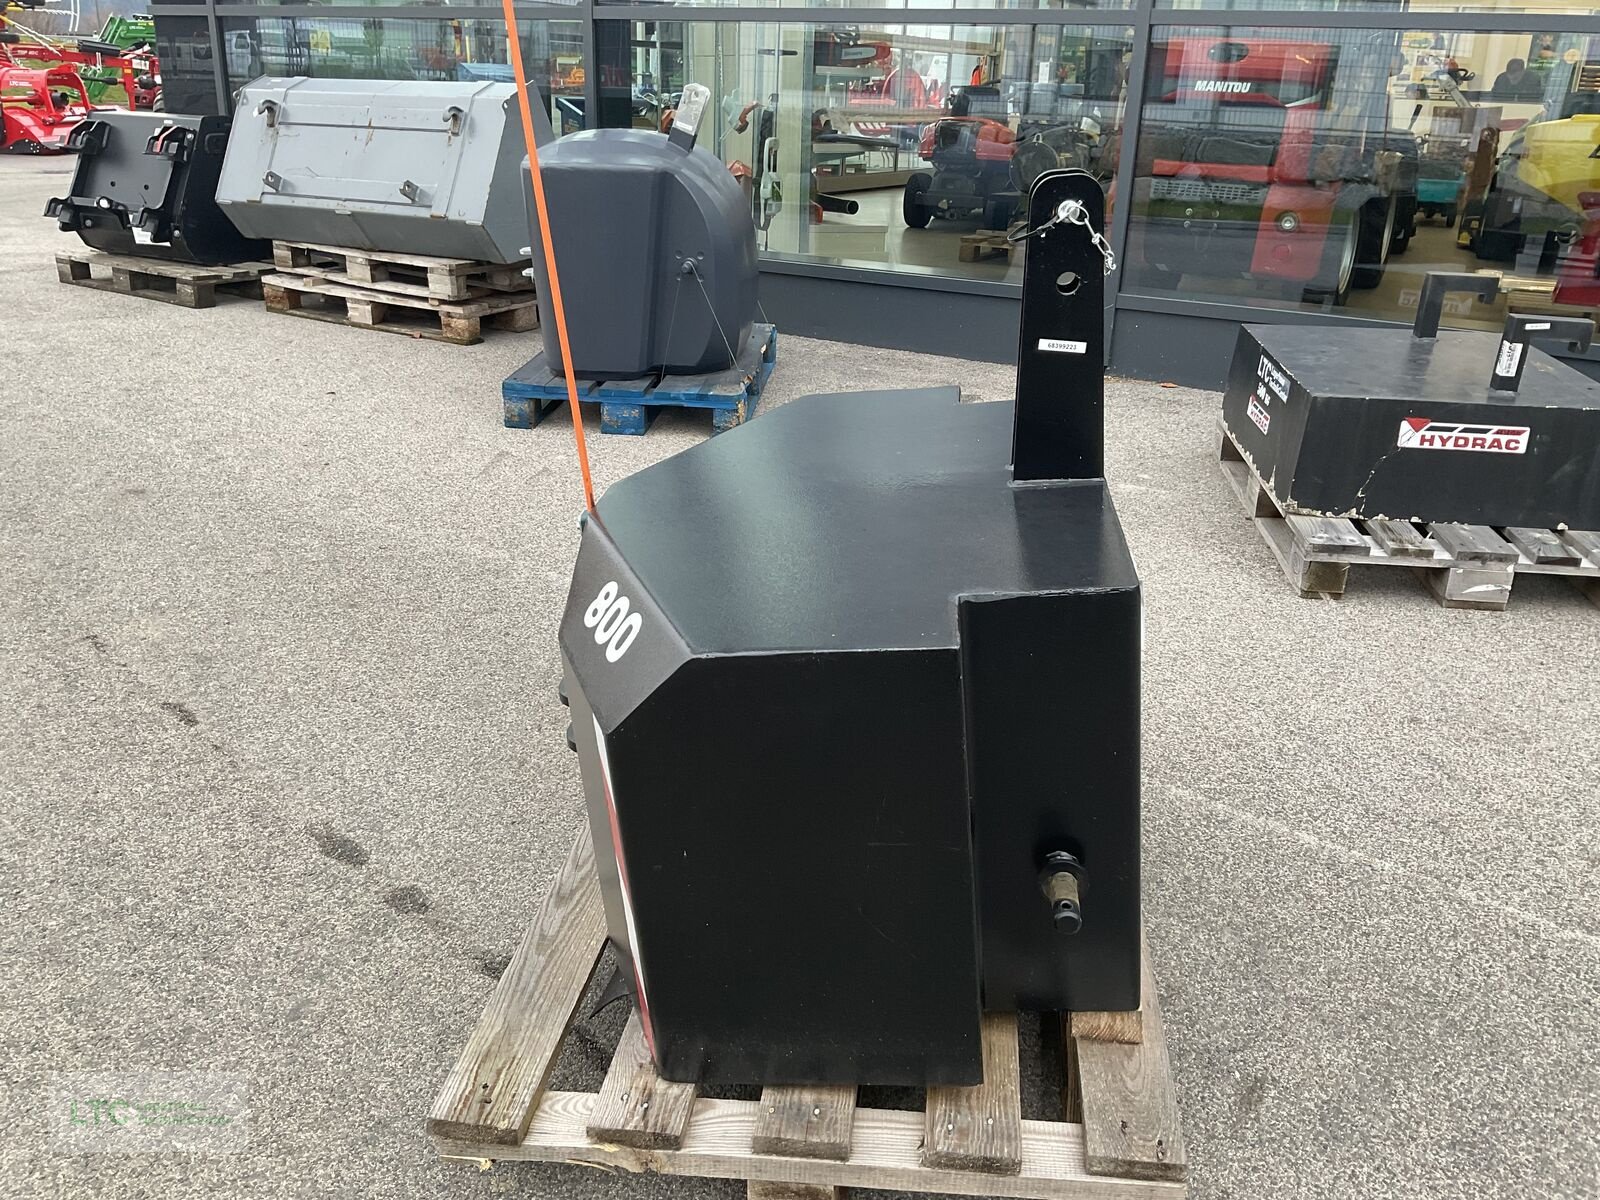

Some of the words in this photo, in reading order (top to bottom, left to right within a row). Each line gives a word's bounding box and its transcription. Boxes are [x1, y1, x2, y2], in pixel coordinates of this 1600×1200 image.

[1194, 80, 1251, 93] MANITOU
[1047, 342, 1077, 351] 68399223
[1257, 354, 1272, 383] LTC
[1419, 434, 1521, 451] HYDRAC
[583, 581, 643, 663] 800
